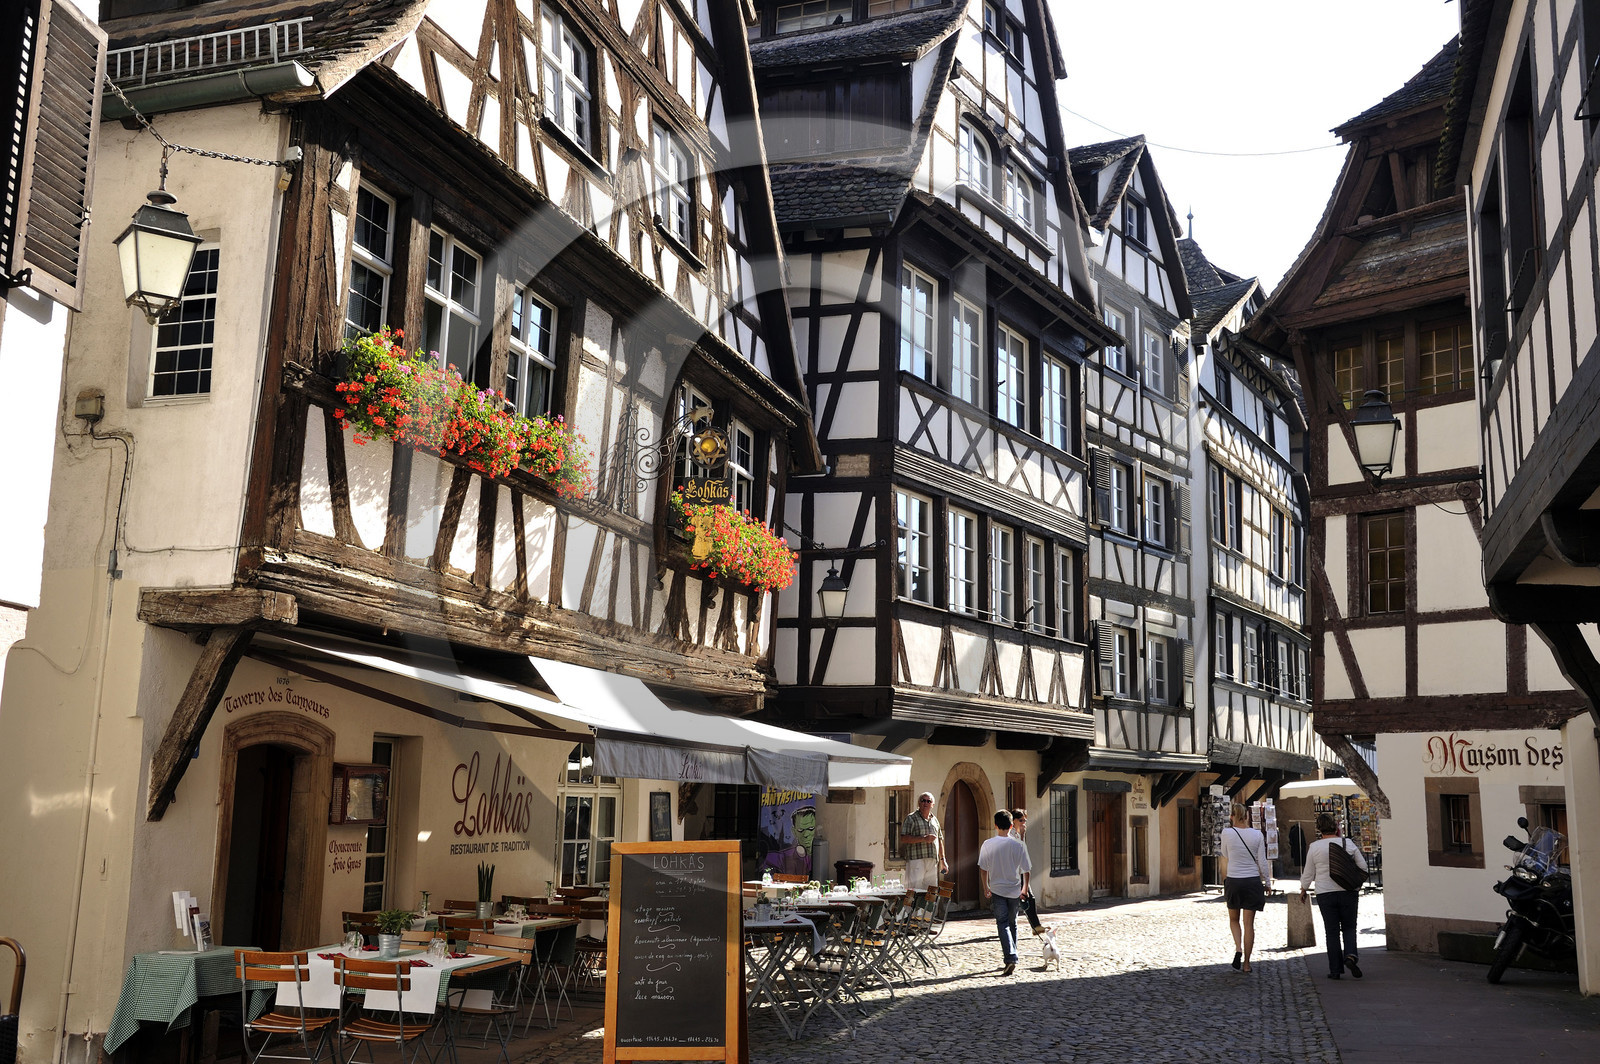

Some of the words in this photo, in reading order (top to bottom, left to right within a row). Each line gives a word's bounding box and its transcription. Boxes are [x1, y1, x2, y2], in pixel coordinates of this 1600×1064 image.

[685, 479, 730, 503] Lohkäs
[223, 690, 265, 713] Taverne
[268, 686, 283, 703] des
[285, 688, 330, 719] Tanneurs
[1423, 732, 1521, 776] Maison
[1524, 736, 1564, 771] des
[452, 750, 533, 837] Lohkäs
[328, 840, 363, 855] Choucroute
[450, 842, 490, 855] RESTAURANT
[490, 842, 499, 853] DE
[501, 841, 531, 852] TRADITION
[347, 856, 362, 874] Gras
[653, 853, 705, 870] LOHKÄS
